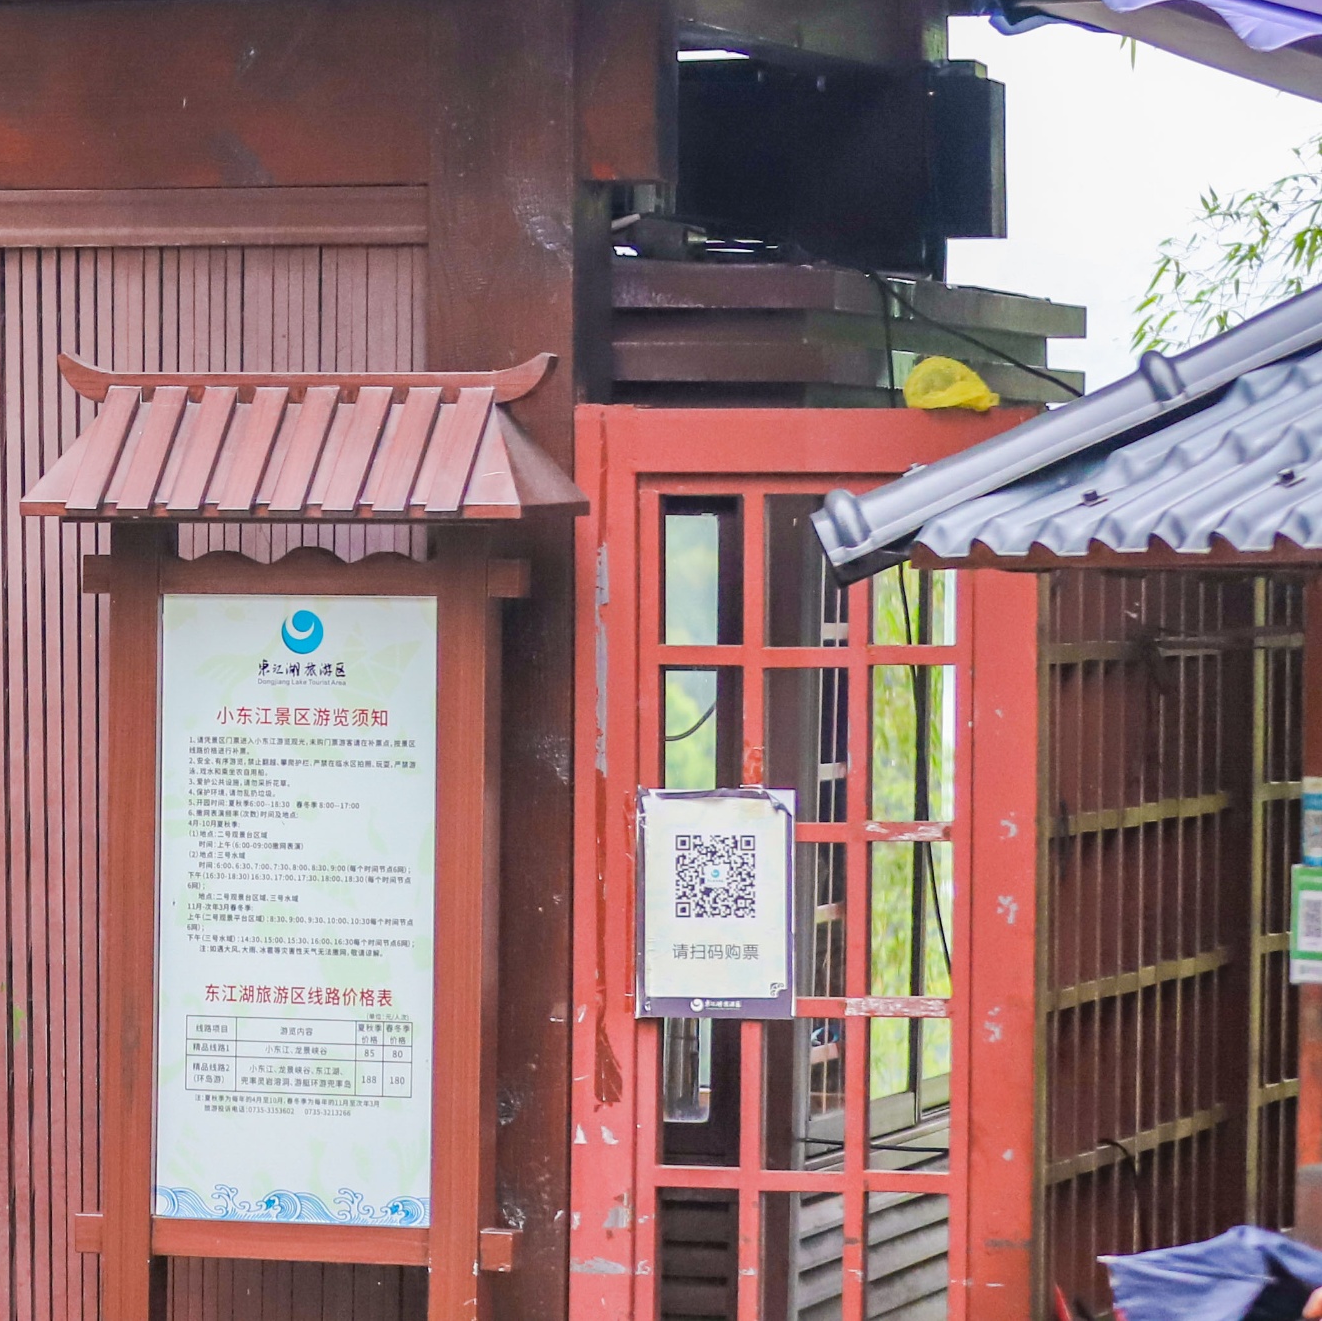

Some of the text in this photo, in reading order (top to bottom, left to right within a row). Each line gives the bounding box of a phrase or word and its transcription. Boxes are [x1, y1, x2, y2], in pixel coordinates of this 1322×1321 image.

[257, 678, 290, 686] Dongjiang
[291, 678, 307, 686] Lake
[308, 678, 331, 686] Tourist
[216, 706, 388, 728] 小东江景区游览须知
[672, 943, 759, 960] 请扫码购票
[205, 984, 393, 1007] 东江湖旅游区线路价格表
[196, 1024, 228, 1033] 线路项目
[280, 1027, 313, 1036] 游览内容
[358, 1023, 382, 1033] 夏秋季
[386, 1024, 410, 1033] 春冬季
[361, 1036, 378, 1044] 价格
[390, 1036, 406, 1045] 价格
[193, 1043, 230, 1052] 精品线路1
[364, 1049, 375, 1057] 85
[392, 1050, 403, 1058] 80
[192, 1063, 230, 1072] 精品线路2
[361, 1075, 377, 1084] 188
[389, 1076, 405, 1085] 180
